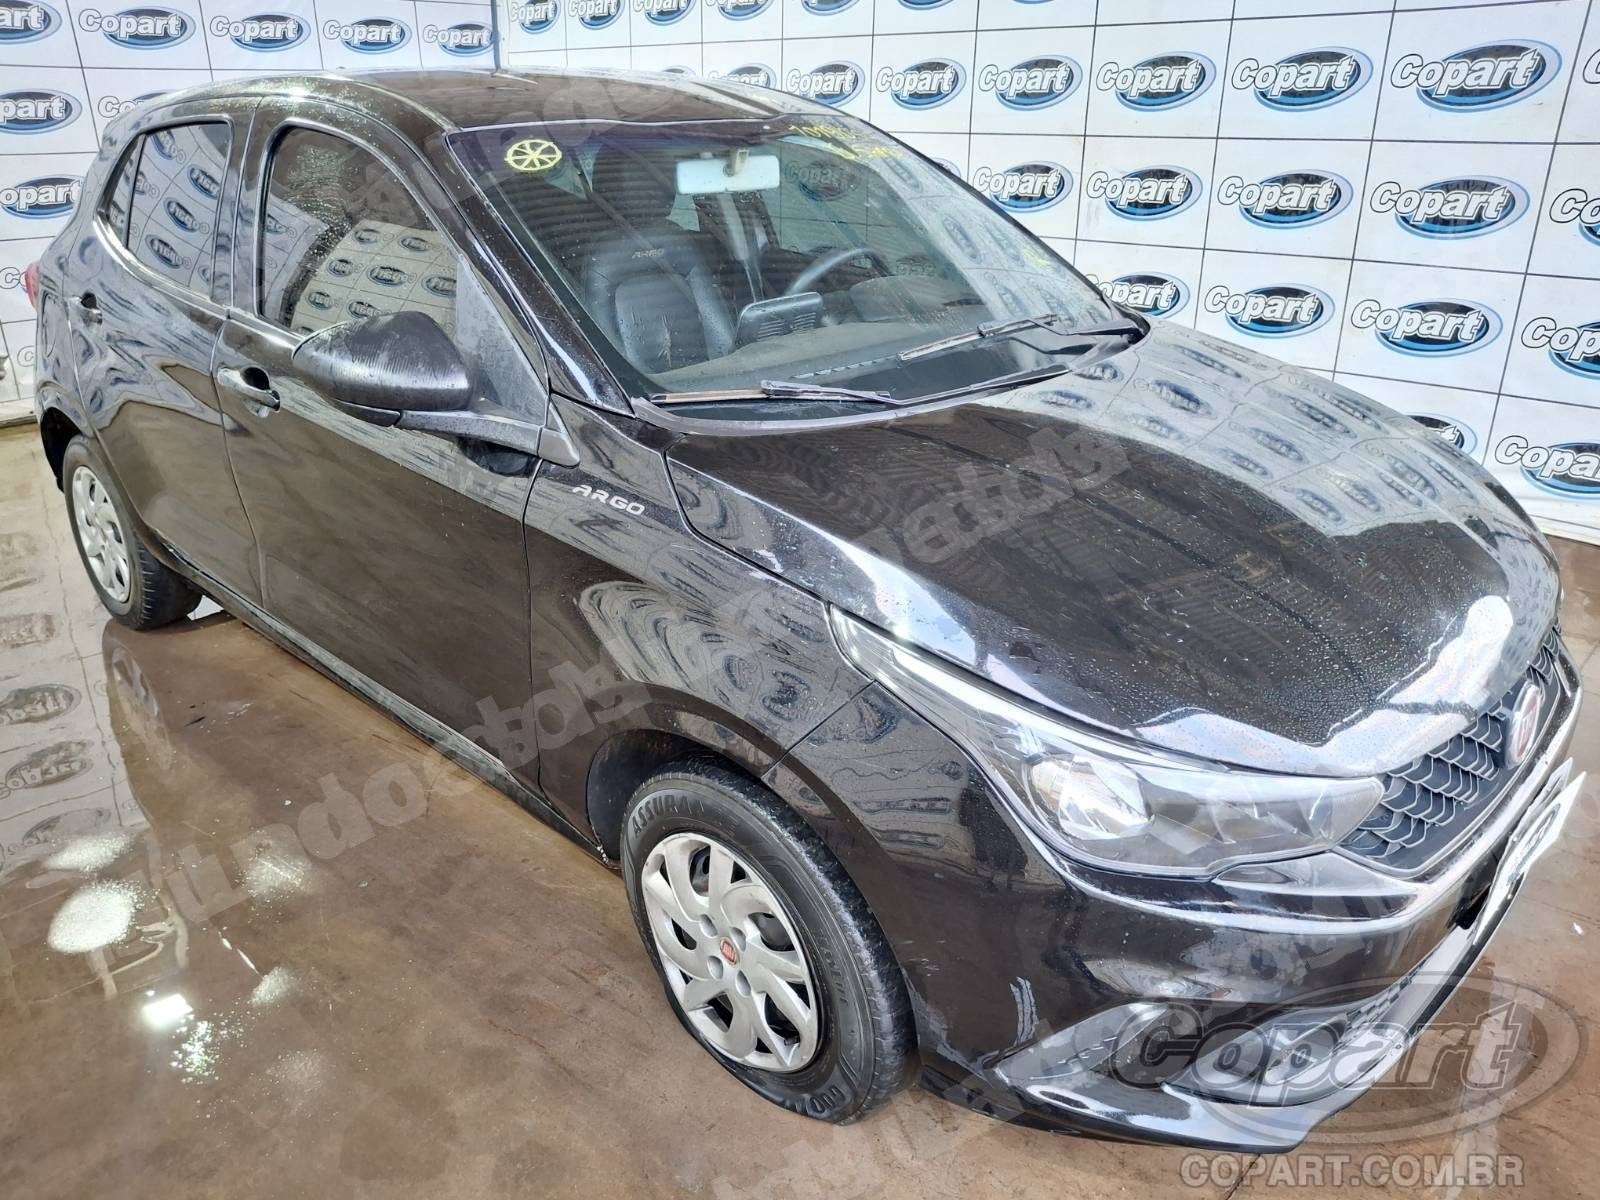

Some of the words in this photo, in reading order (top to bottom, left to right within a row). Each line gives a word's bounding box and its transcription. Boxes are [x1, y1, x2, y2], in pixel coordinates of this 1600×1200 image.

[0, 5, 44, 29] art
[78, 8, 181, 40] Copart
[510, 2, 556, 26] Copart
[568, 0, 617, 20] Copart
[210, 16, 298, 41] Copart
[323, 19, 402, 45] Copart
[423, 23, 492, 47] Copart
[786, 66, 856, 98] Copart
[876, 65, 956, 101] Copart
[979, 61, 1071, 100] Copart
[1096, 58, 1203, 99] Copart
[1231, 55, 1357, 99] Copart
[1391, 49, 1541, 97] Copart
[0, 96, 65, 124] part
[0, 180, 82, 211] opart
[973, 166, 1063, 200] Copart
[1086, 171, 1191, 207] Copart
[1217, 175, 1337, 215] Copart
[1370, 181, 1510, 224] Copart
[1204, 285, 1322, 324] Copart
[1351, 299, 1488, 343] Copart
[1521, 317, 1600, 361] Cop
[1495, 435, 1600, 480] Copa
[572, 484, 645, 515] ARGO
